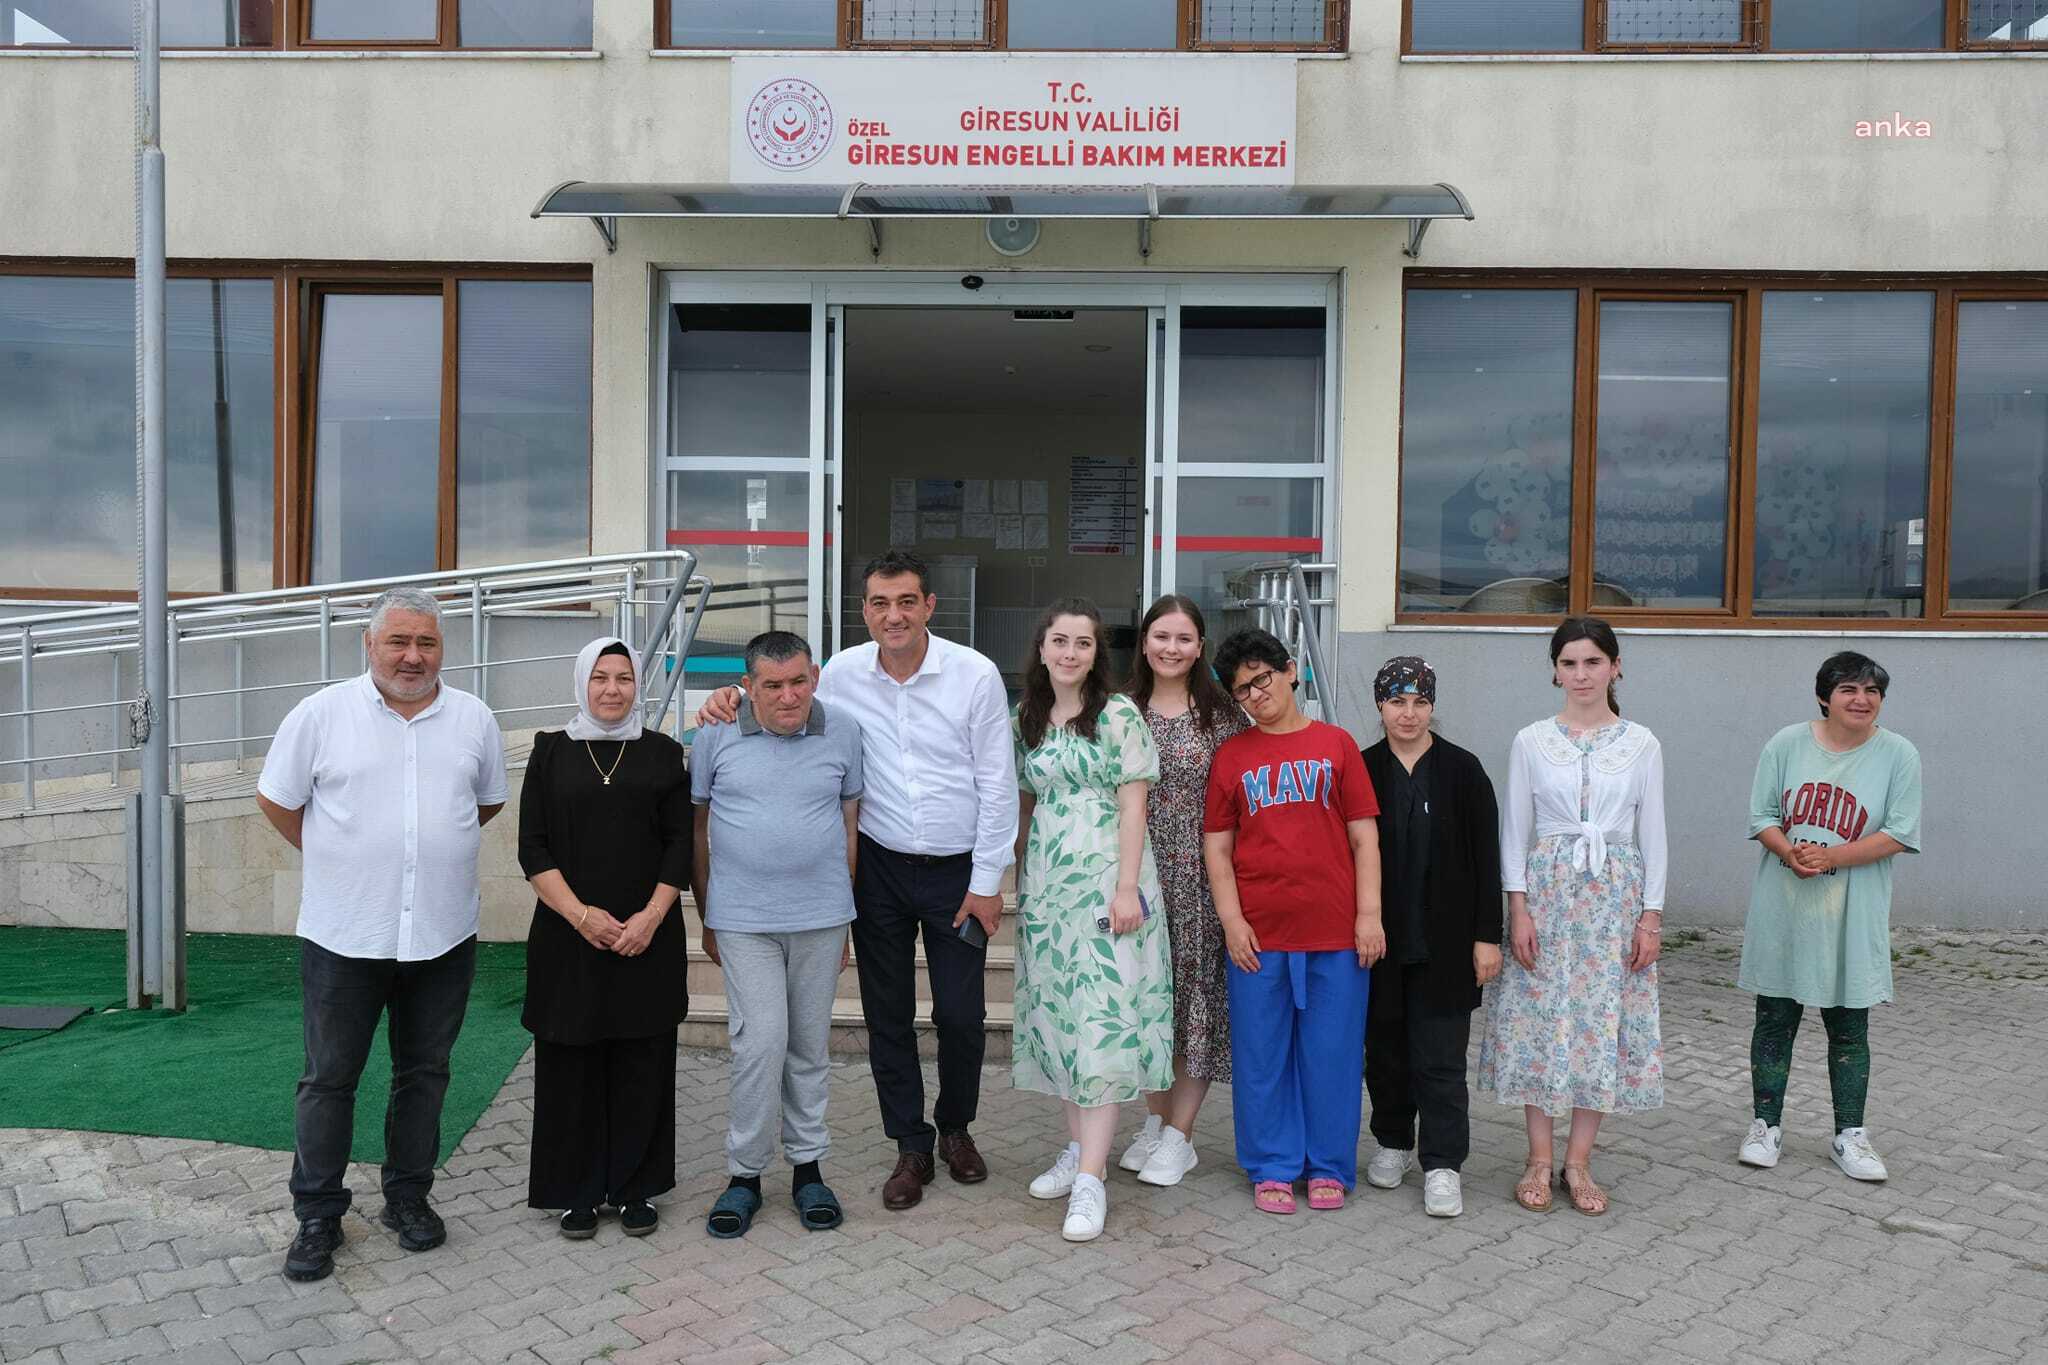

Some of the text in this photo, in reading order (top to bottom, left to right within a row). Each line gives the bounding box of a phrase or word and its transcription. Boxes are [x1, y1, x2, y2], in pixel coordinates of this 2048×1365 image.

[1048, 81, 1092, 104] T.C.
[848, 119, 890, 137] ÖZEL
[960, 107, 1180, 132] GİRESUN VALİLİĞİ
[847, 139, 1287, 167] GİRESUN ENGELLİ BAKIM MERKEZİ
[1781, 782, 1869, 841] LORID
